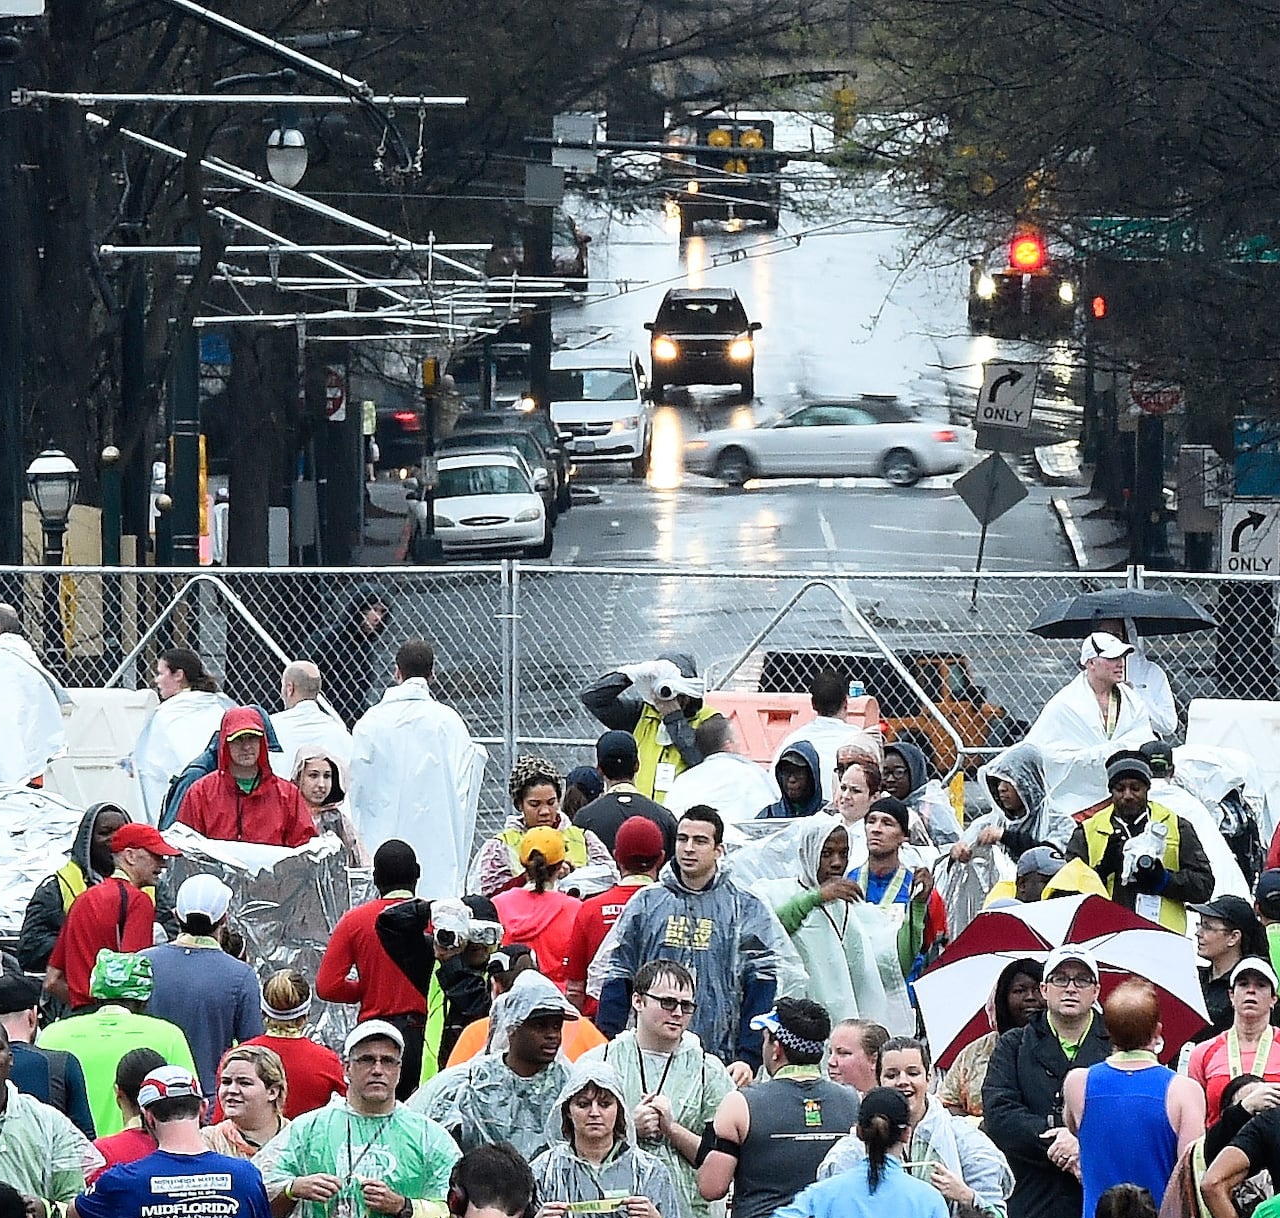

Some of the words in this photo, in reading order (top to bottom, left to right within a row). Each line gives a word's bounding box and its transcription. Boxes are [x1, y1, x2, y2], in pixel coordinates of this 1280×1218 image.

[983, 406, 1023, 423] ONLY
[1228, 557, 1273, 572] ONLY
[141, 1202, 238, 1217] MIDFLORIDA
